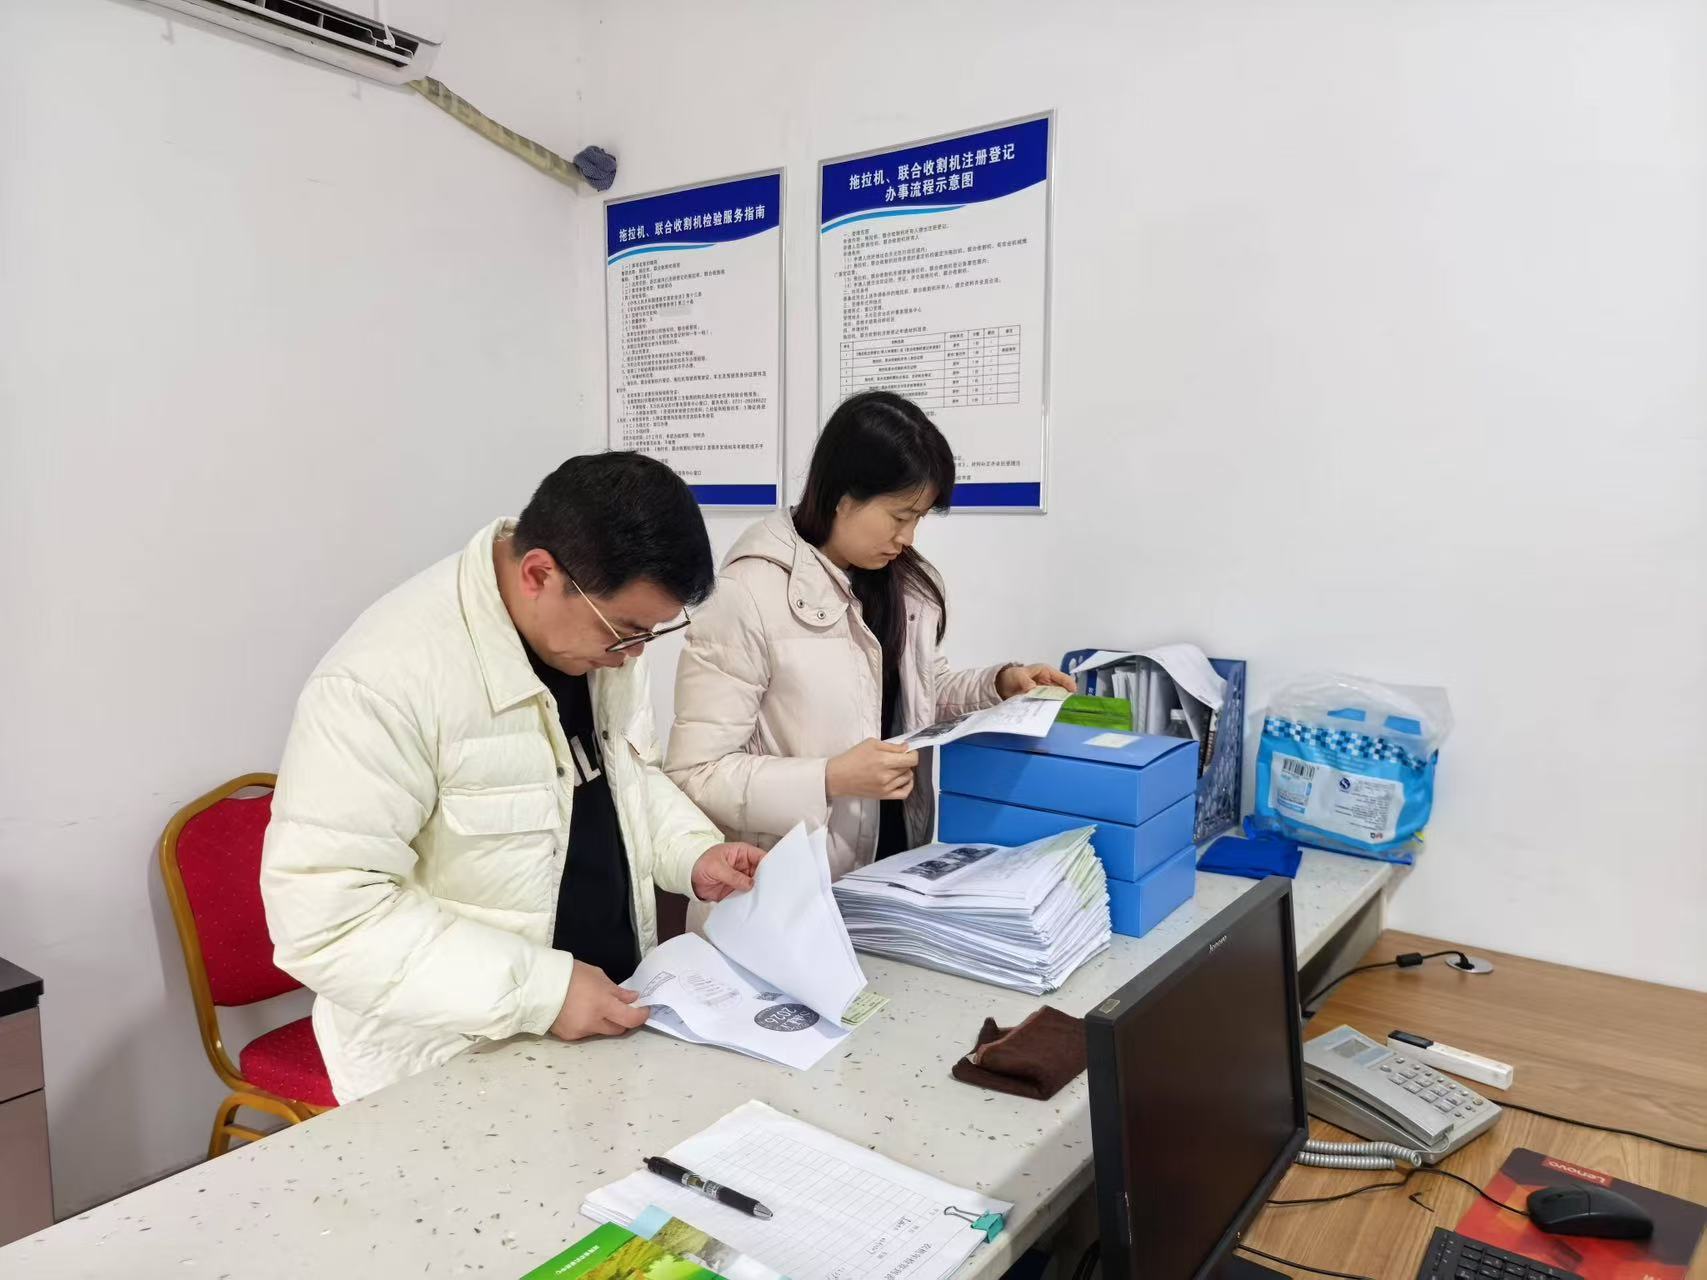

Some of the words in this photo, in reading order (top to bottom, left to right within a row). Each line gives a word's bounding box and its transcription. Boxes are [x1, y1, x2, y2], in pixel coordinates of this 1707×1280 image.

[849, 143, 1015, 189] 拖拉机、联合收割机注册登记
[885, 171, 972, 201] 办事流程示意图
[619, 205, 765, 241] 拖拉机、联合收割机检验服务指南
[1549, 1161, 1605, 1183] Lenovo
